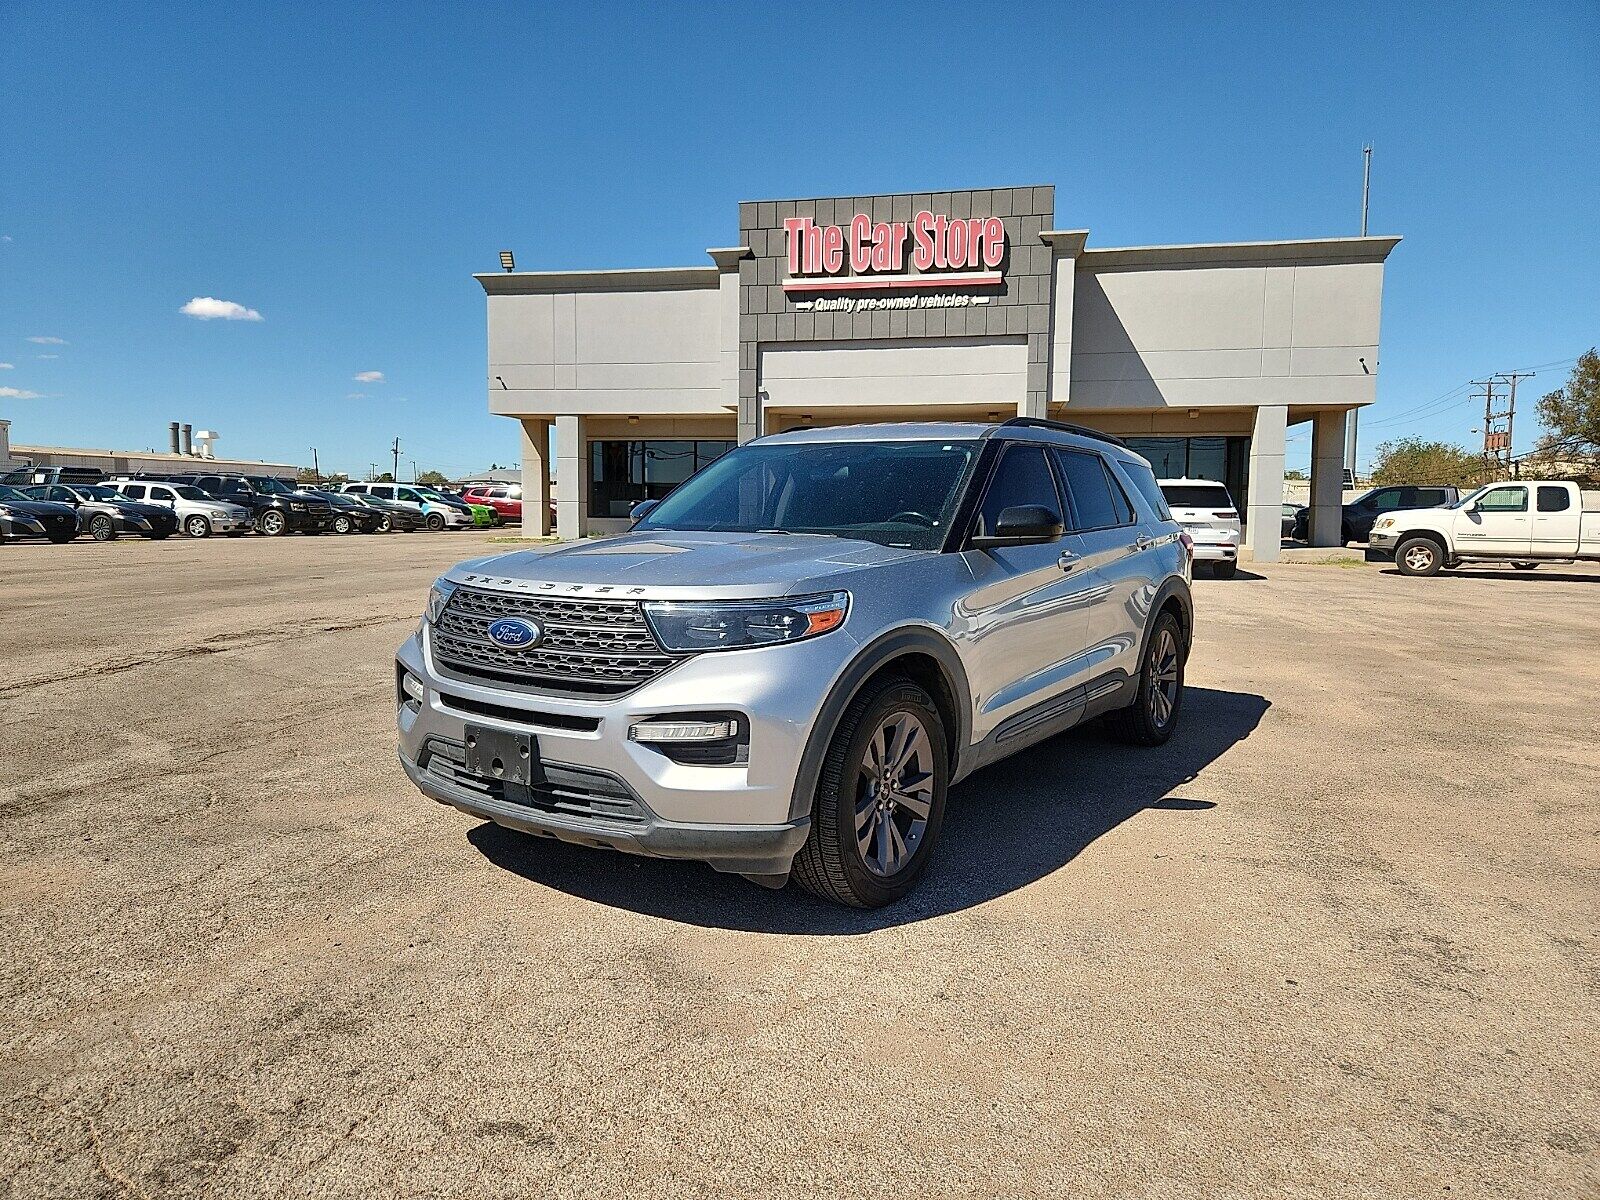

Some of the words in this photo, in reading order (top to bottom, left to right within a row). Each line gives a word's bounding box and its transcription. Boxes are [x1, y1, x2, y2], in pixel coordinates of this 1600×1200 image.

[784, 217, 844, 274] The
[850, 213, 907, 273] Car
[914, 210, 1004, 270] Store
[814, 297, 855, 313] Quality
[856, 296, 918, 313] pre-owned
[920, 293, 969, 308] vehicles
[496, 624, 523, 642] Ford
